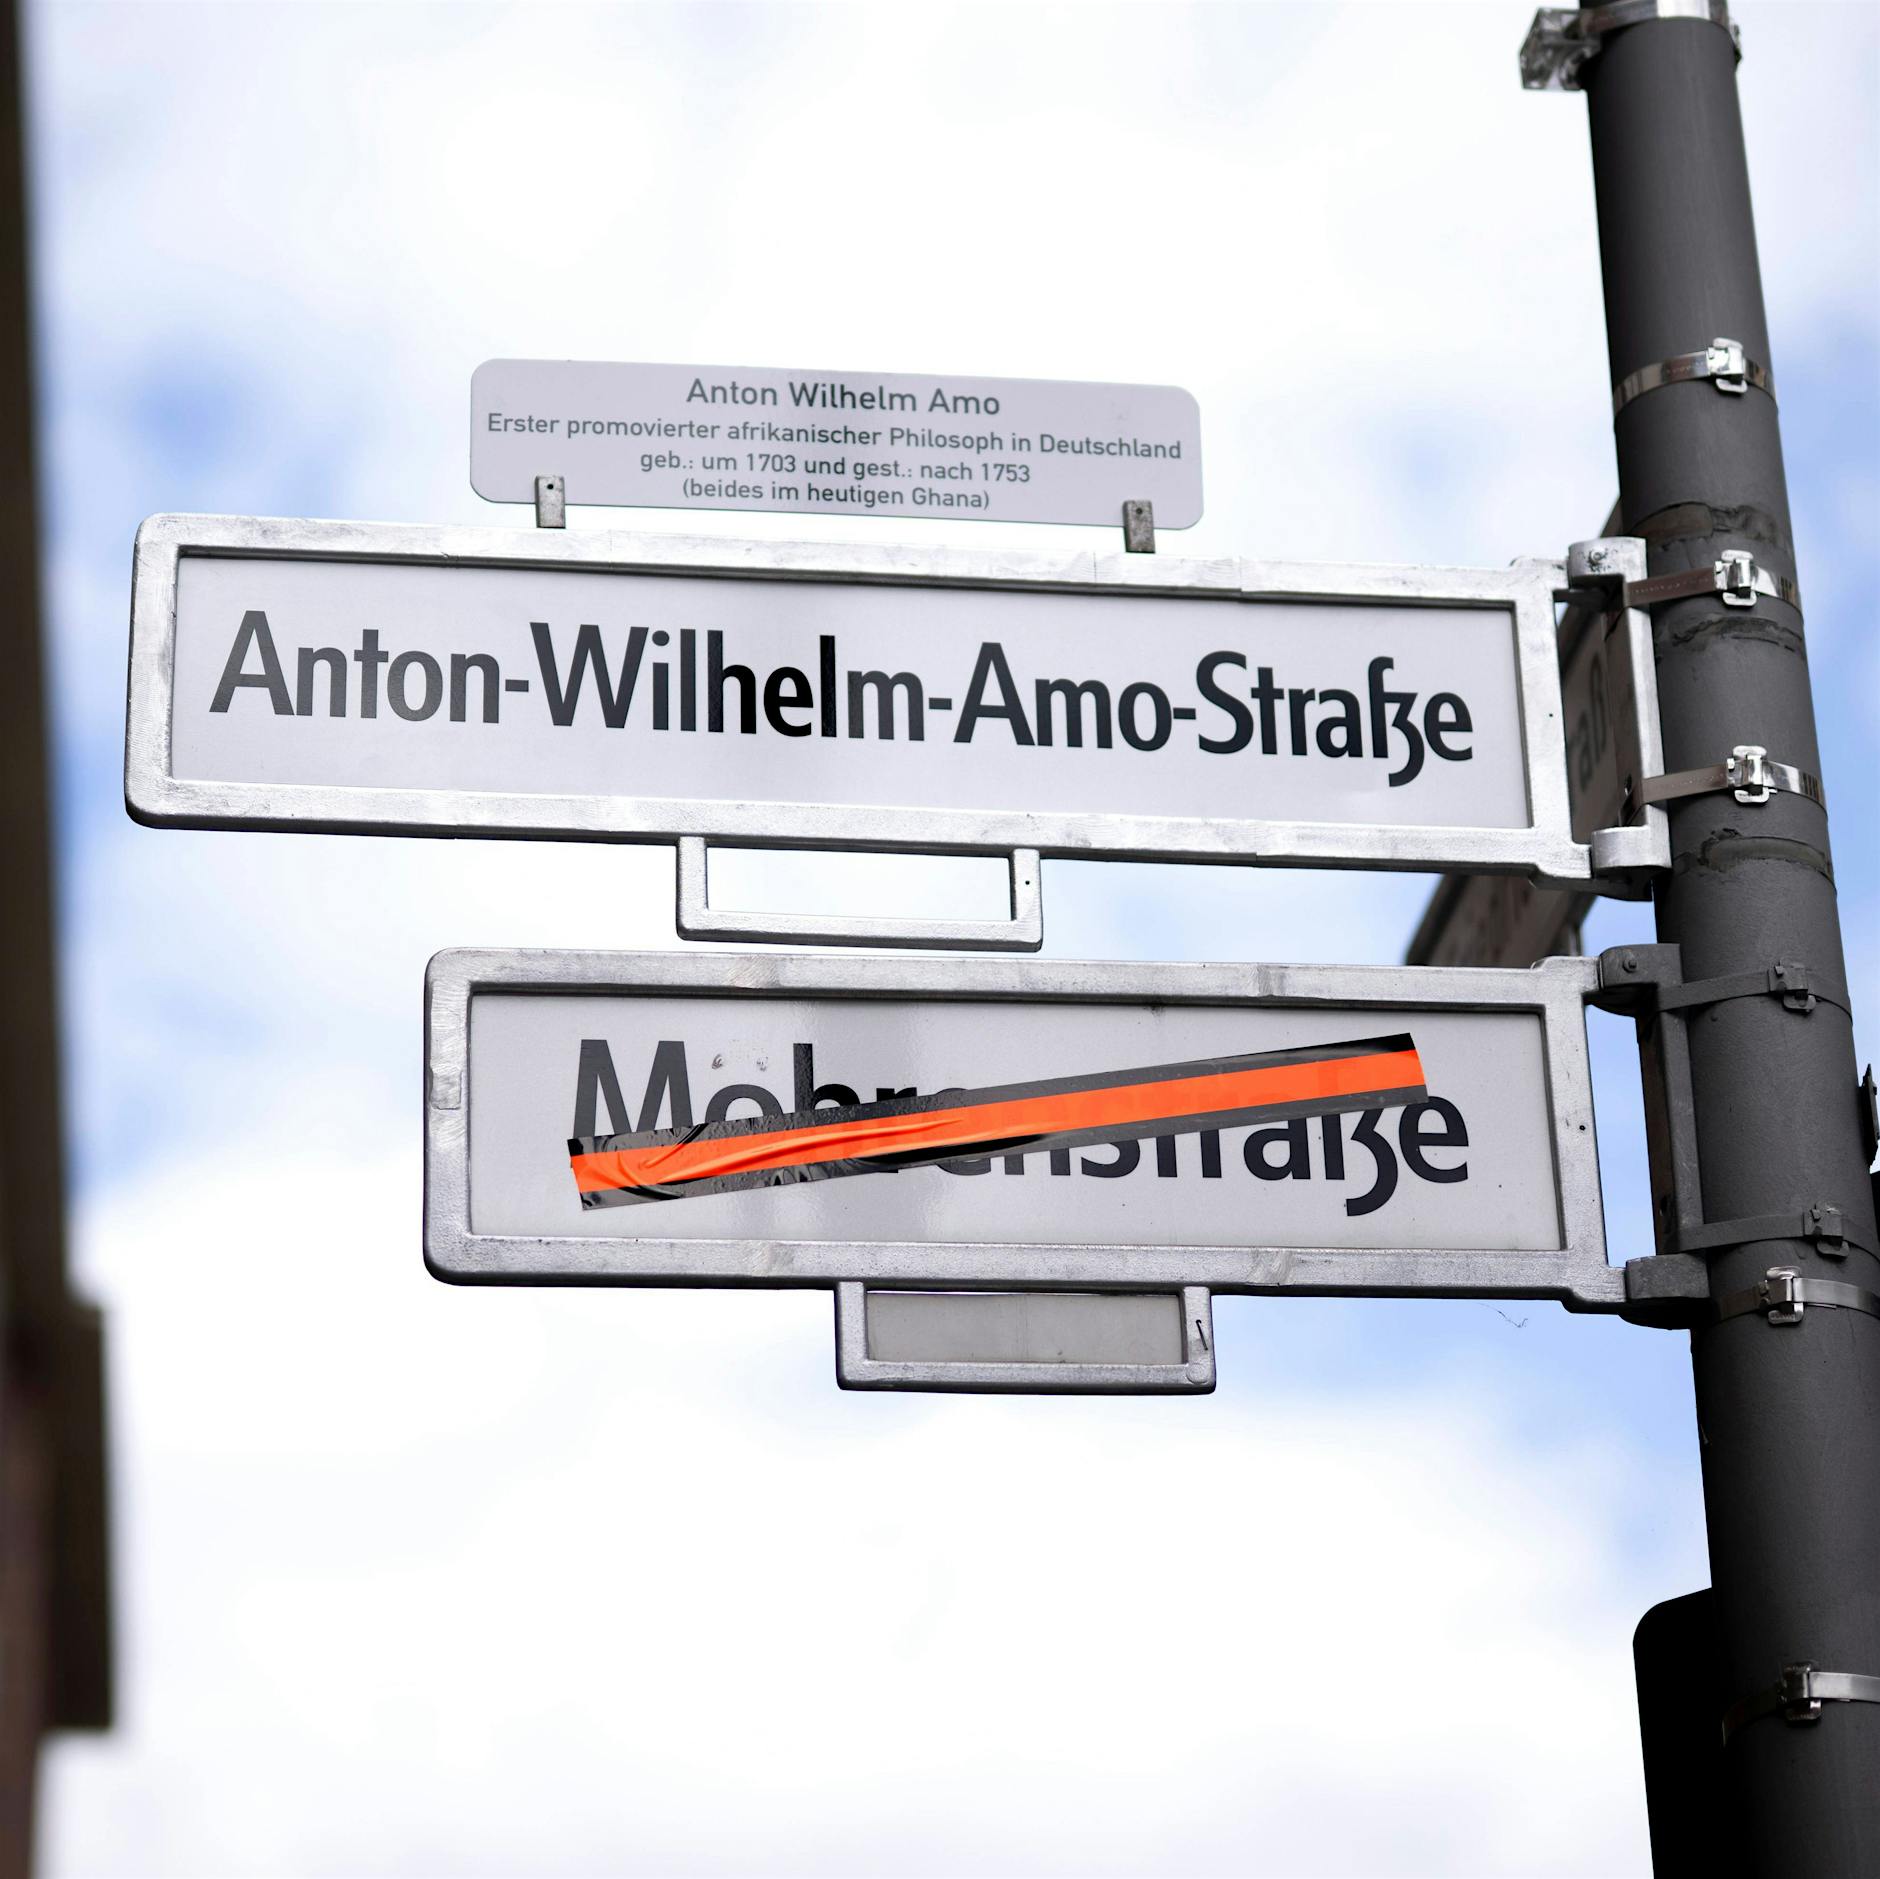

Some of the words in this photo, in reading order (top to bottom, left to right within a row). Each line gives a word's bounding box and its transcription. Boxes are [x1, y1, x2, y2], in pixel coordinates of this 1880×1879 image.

[686, 378, 777, 406] Anton
[789, 382, 916, 411] Wilhelm
[928, 388, 1000, 415] Amo
[489, 413, 559, 433] Erster
[568, 419, 720, 439] promovierter
[728, 422, 882, 445] afrikanischer
[890, 428, 1003, 454] Philosoph
[1012, 433, 1031, 451] in
[1040, 434, 1181, 459] Deutschland
[641, 451, 692, 472] geb.:
[703, 457, 736, 470] um
[747, 453, 796, 472] 1703
[804, 457, 845, 475] und
[853, 461, 911, 481] gest.:
[921, 462, 972, 480] nach
[982, 463, 1030, 482] 1753
[683, 478, 763, 498] (beides
[772, 481, 799, 500] im
[808, 479, 903, 508] heutigen
[912, 487, 989, 509] Ghana)
[210, 610, 1473, 788] Anton-Wilhelm-Amo-Straße
